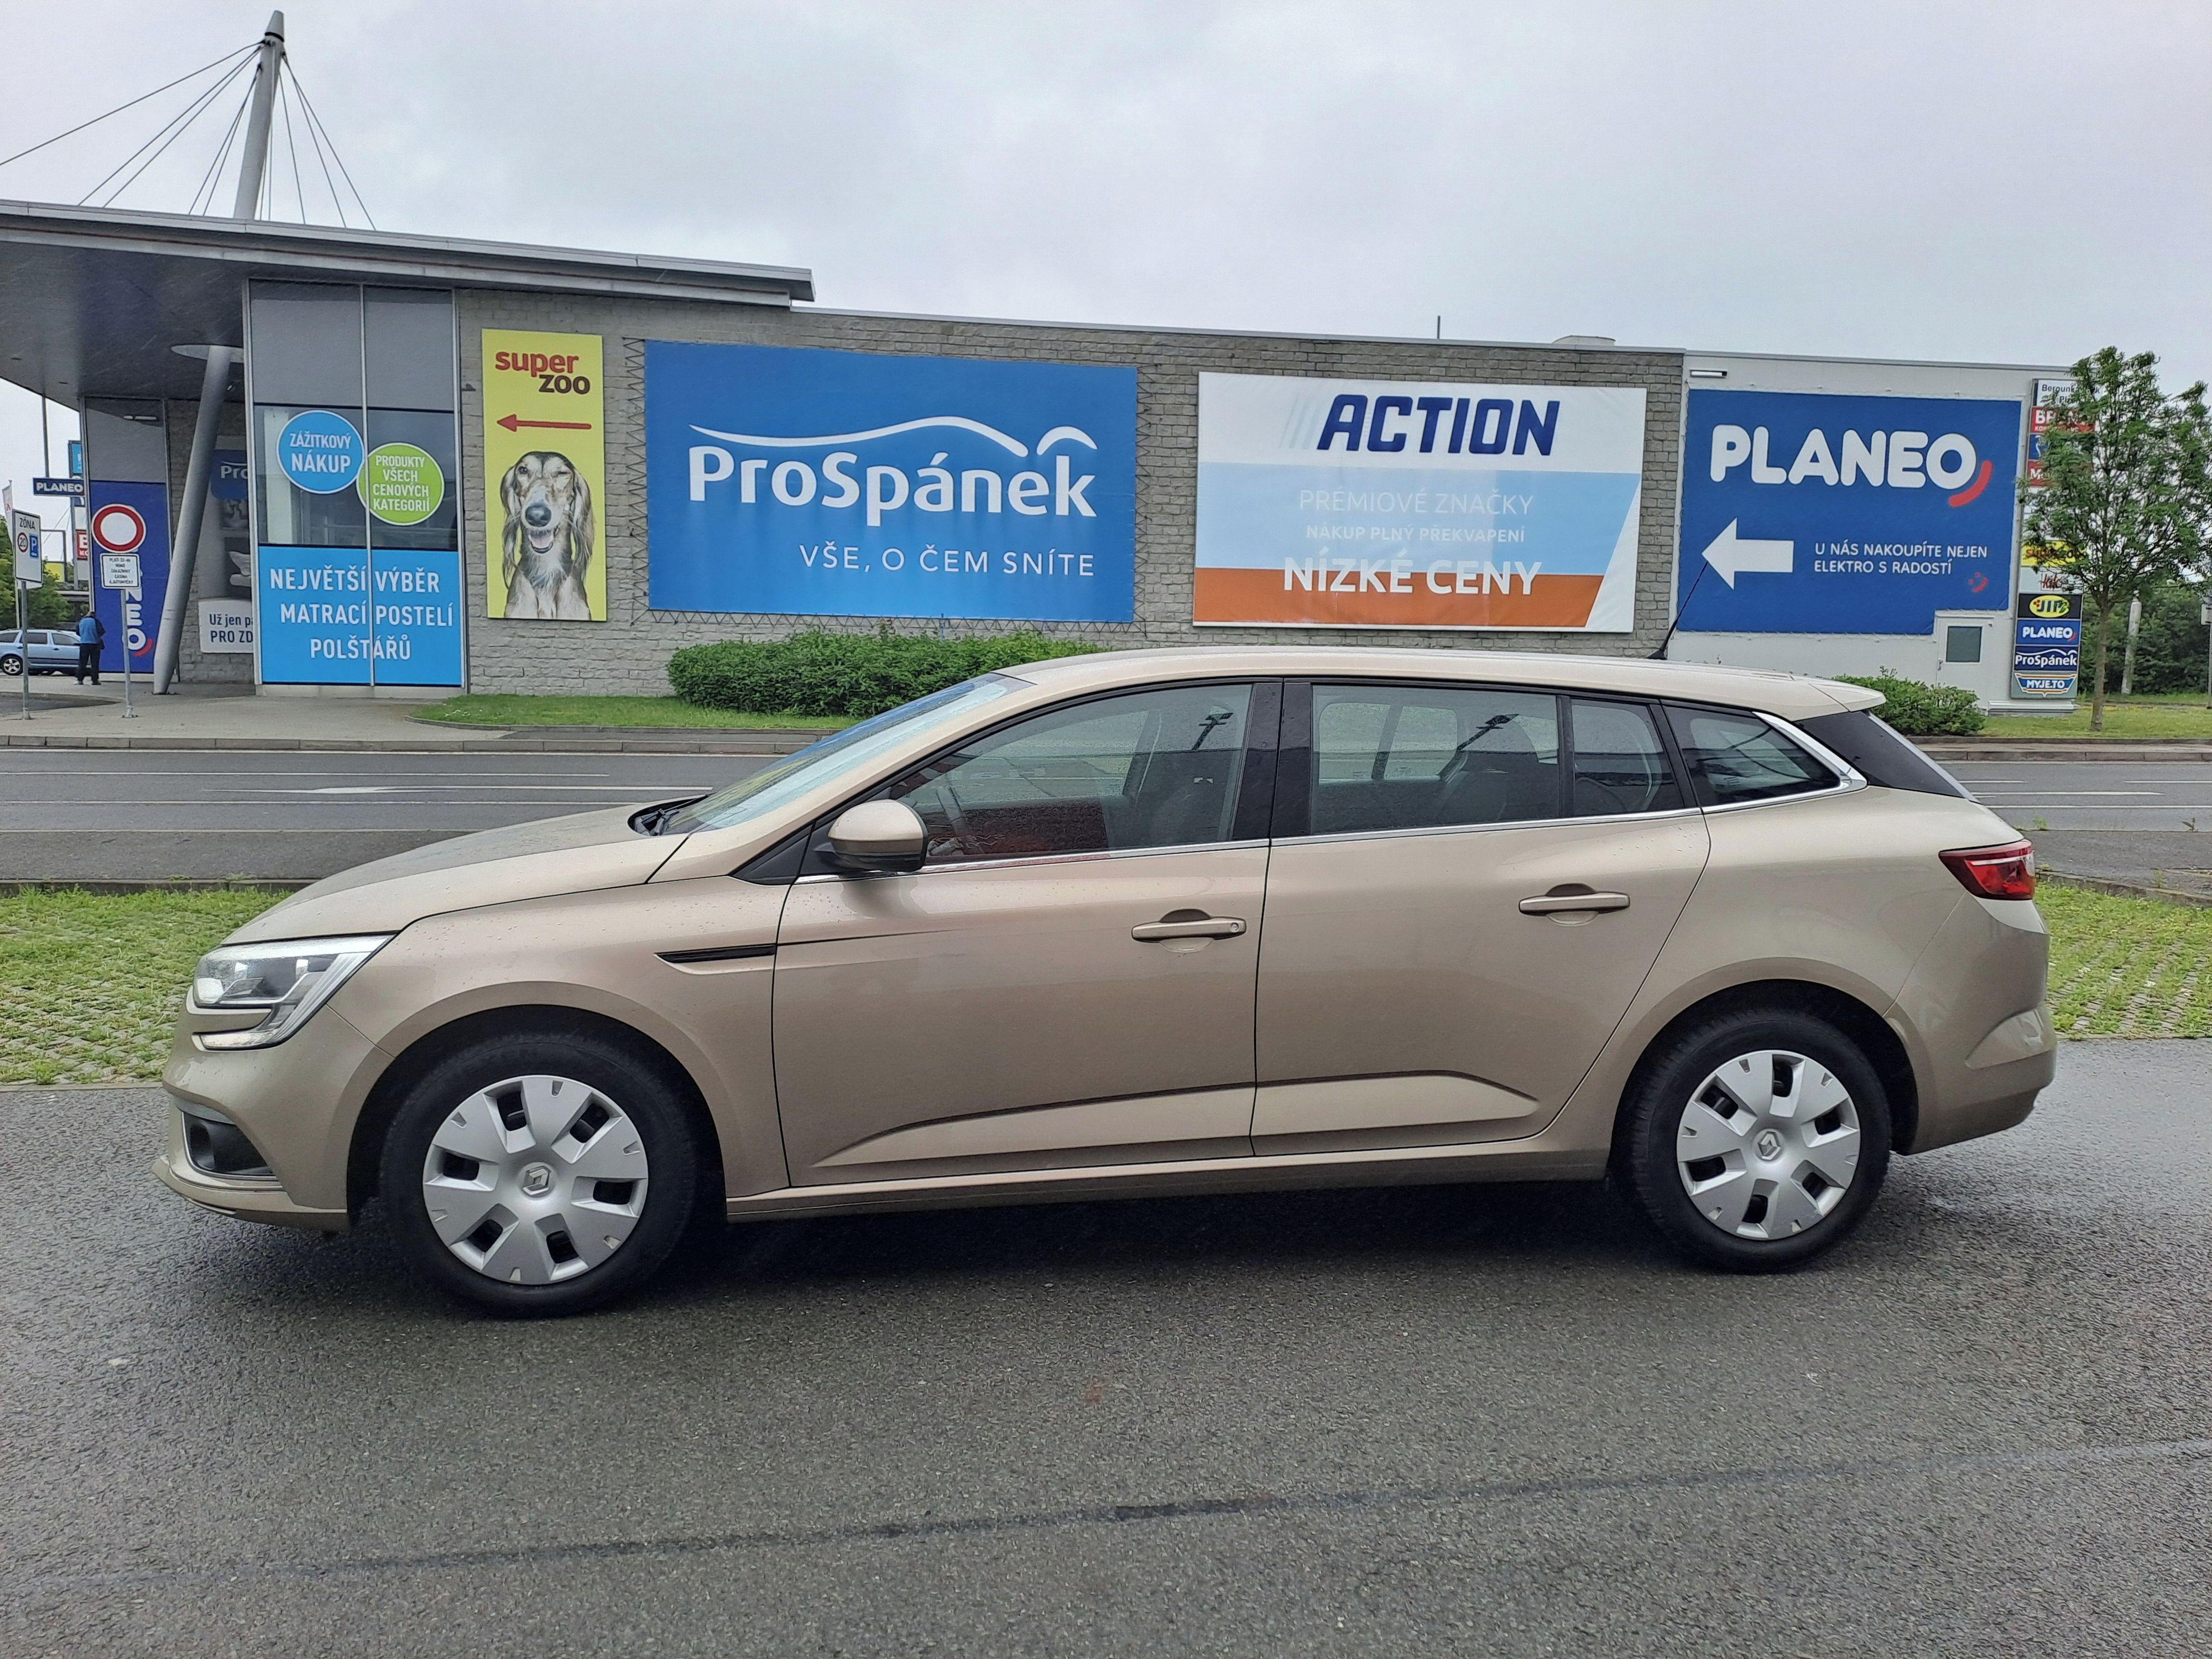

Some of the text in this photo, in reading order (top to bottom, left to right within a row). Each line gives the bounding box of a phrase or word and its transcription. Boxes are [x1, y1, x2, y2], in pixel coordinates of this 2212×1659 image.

[495, 351, 580, 377] super
[539, 374, 591, 394] zoo
[1317, 394, 1560, 456] ACTION
[289, 430, 352, 450] ZÁŽITKOVÝ
[291, 450, 351, 473] NÁKUP
[375, 455, 425, 468] PRODUKTY
[1710, 424, 1977, 489] PLANEO
[382, 467, 418, 482] VŠECH
[36, 482, 83, 493] PLANEO
[373, 482, 429, 497] CENOVÝCH
[688, 446, 1097, 526] ProSpánek
[373, 497, 430, 512] KATEGORIÍ
[1300, 488, 1535, 515] PRÉMIOVÉ ZNAČKY
[19, 516, 36, 530] ZÓNA
[1306, 521, 1525, 542] NÁKUP PLNÝ PŘEKVAPENÍ
[19, 537, 27, 547] 20
[1815, 539, 1987, 557] U NÁS NAKOUPÍTE NEJEN
[799, 540, 1094, 576] VŠE, O ČEM SNÍTE
[1814, 559, 1953, 575] ELEKTRO S RADOSTÍ
[270, 565, 440, 593] NEJVĚTŠÍ VÝBĚR
[1284, 546, 1542, 596] NÍZKÉ CENY
[210, 614, 222, 625] Už
[225, 614, 241, 628] jen
[280, 600, 453, 626] MATRACÍ POSTELÍ
[211, 630, 234, 643] PRO
[2022, 627, 2073, 639] PLANEO
[310, 634, 411, 660] POLŠTÁŘŮ
[2015, 654, 2077, 668] ProSpánek
[2026, 680, 2065, 688] MYJE.TO
